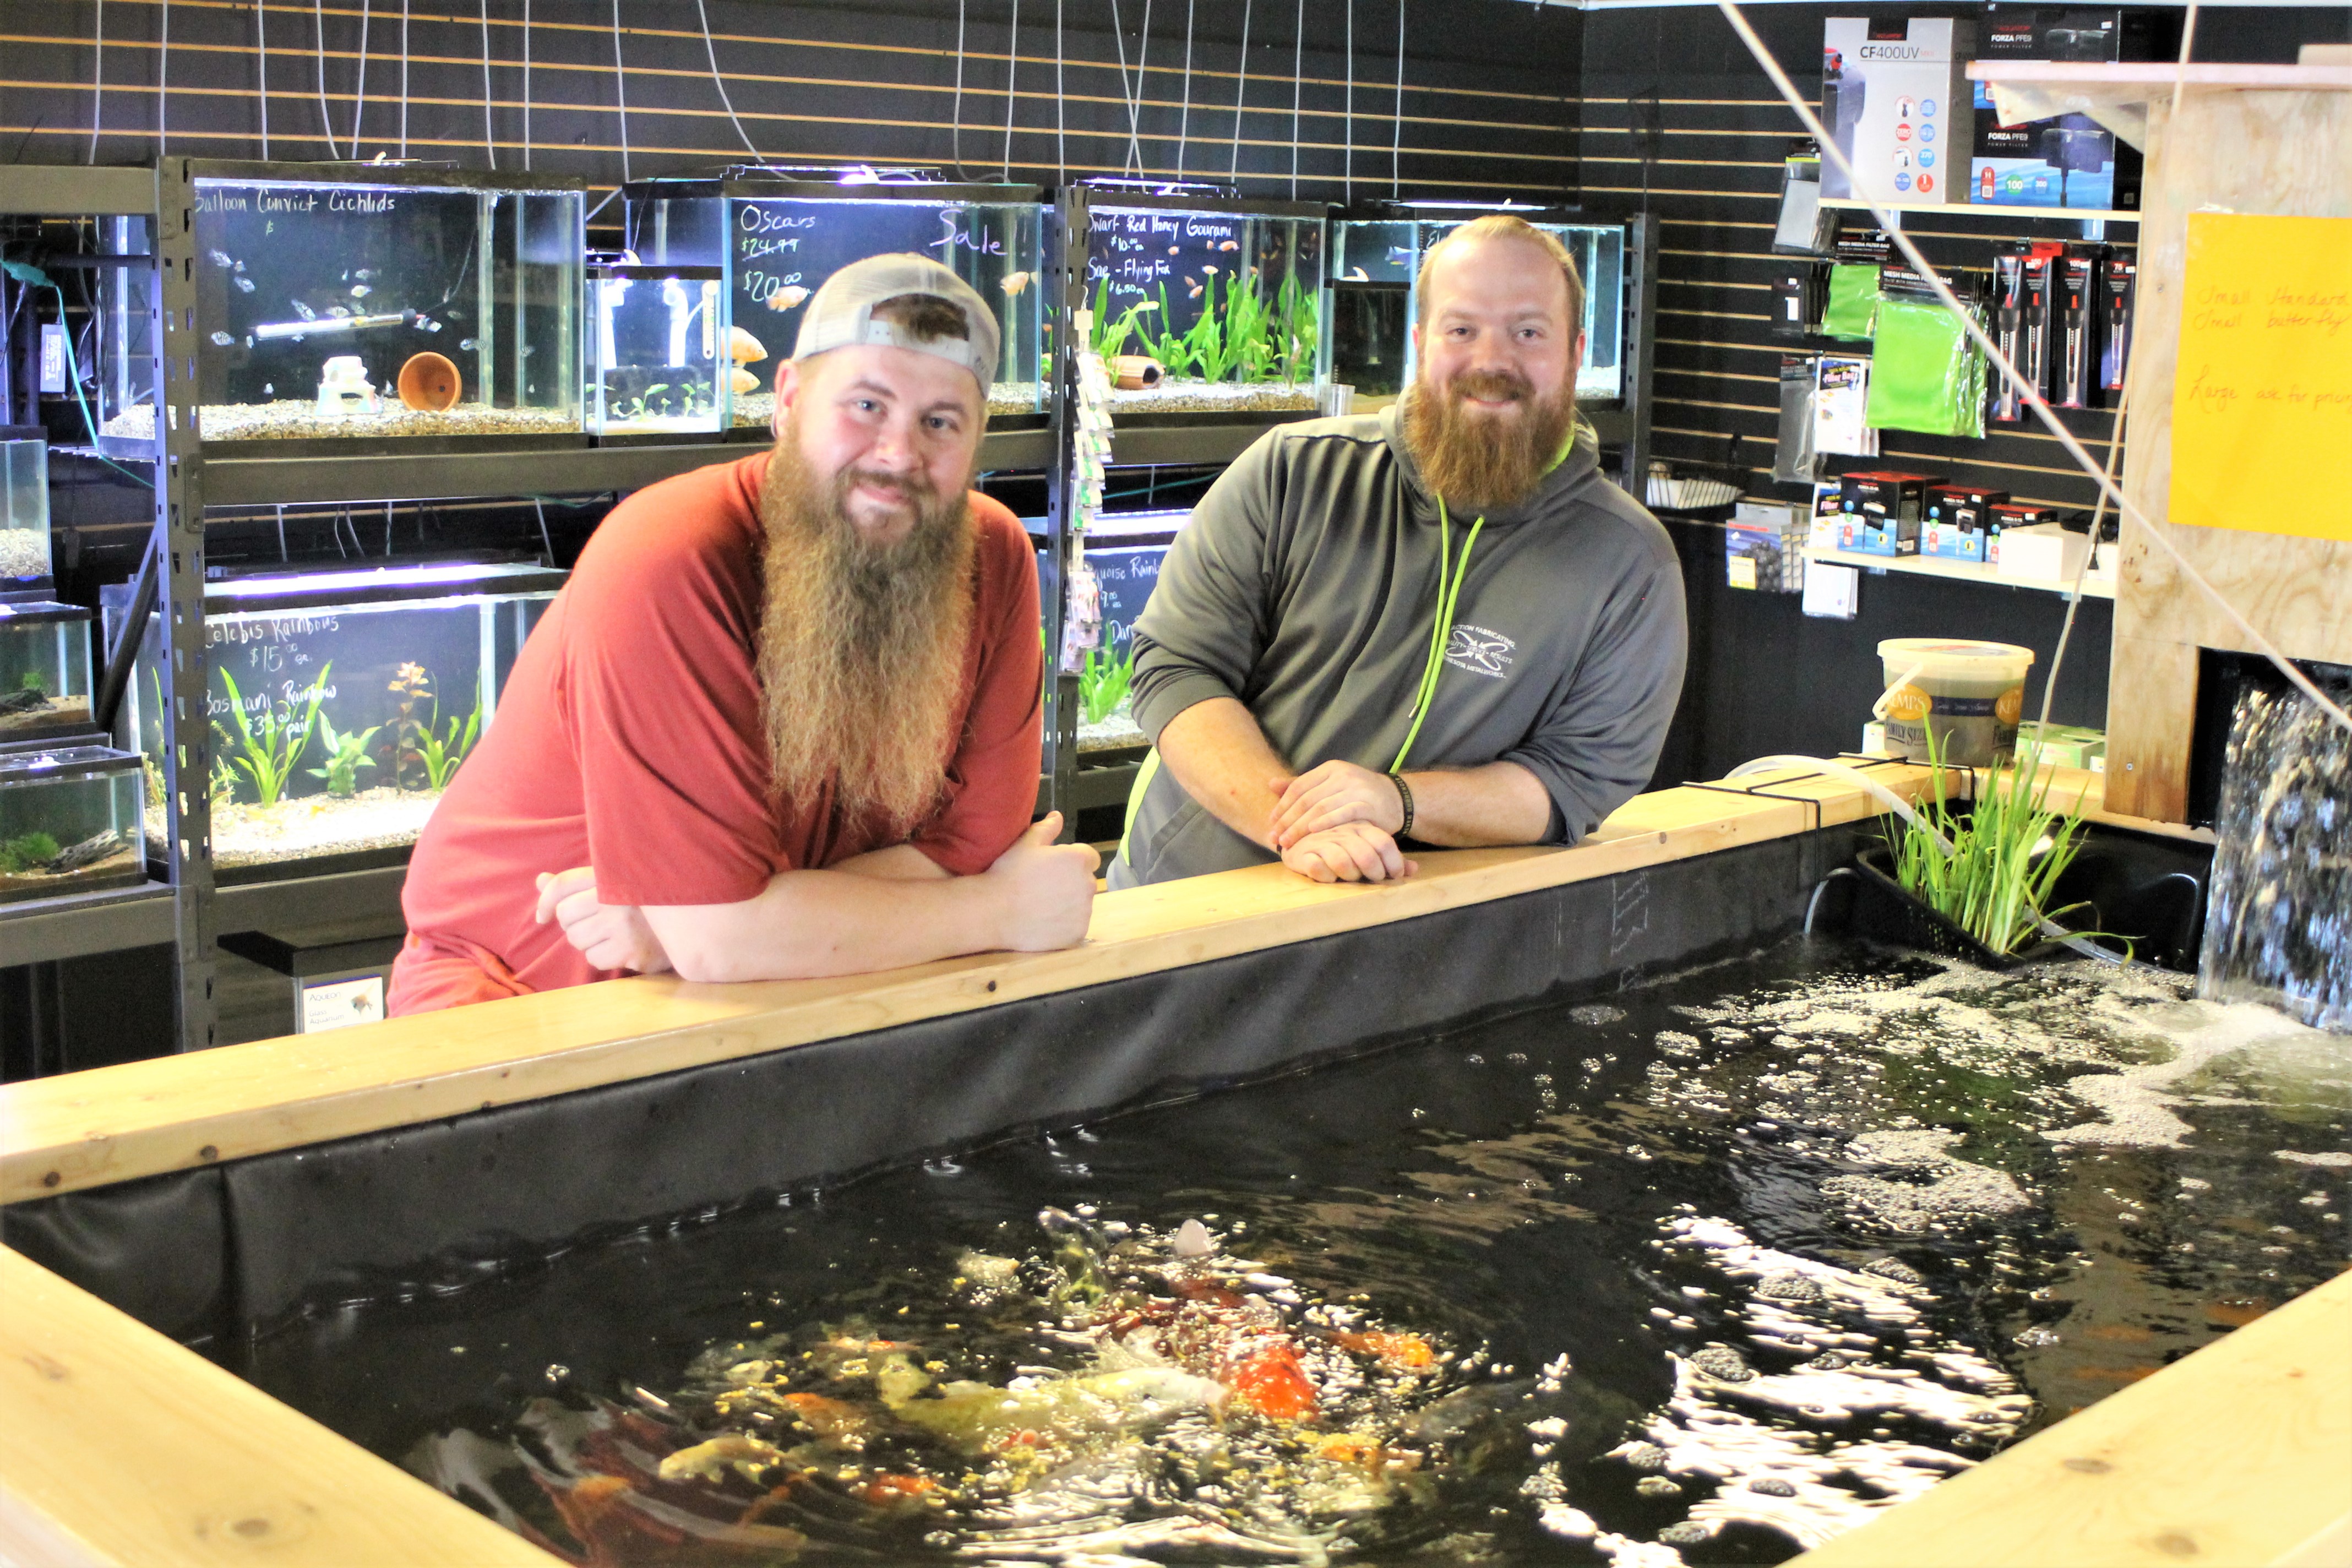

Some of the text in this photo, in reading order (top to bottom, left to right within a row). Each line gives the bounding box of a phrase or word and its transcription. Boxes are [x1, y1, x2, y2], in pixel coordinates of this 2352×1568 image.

[1860, 46, 1920, 59] CF400UV
[1988, 132, 2011, 140] FORZA
[2007, 180, 2023, 189] 100
[257, 188, 318, 213] Convict
[330, 189, 396, 213] Cichlids
[741, 204, 816, 233] Oscars
[1127, 215, 1146, 232] Red
[1152, 215, 1179, 241] Honey
[1186, 215, 1232, 237] Gourami
[1124, 258, 1153, 283] Flying
[1155, 259, 1170, 275] Fox
[1901, 271, 1920, 280] MEDIA
[2189, 363, 2238, 414] Large
[1130, 556, 1161, 578] Rainb
[271, 616, 339, 643] Rainbows
[282, 679, 337, 706] Rainbow
[286, 715, 312, 742] pair
[309, 1014, 344, 1025] Aquarium
